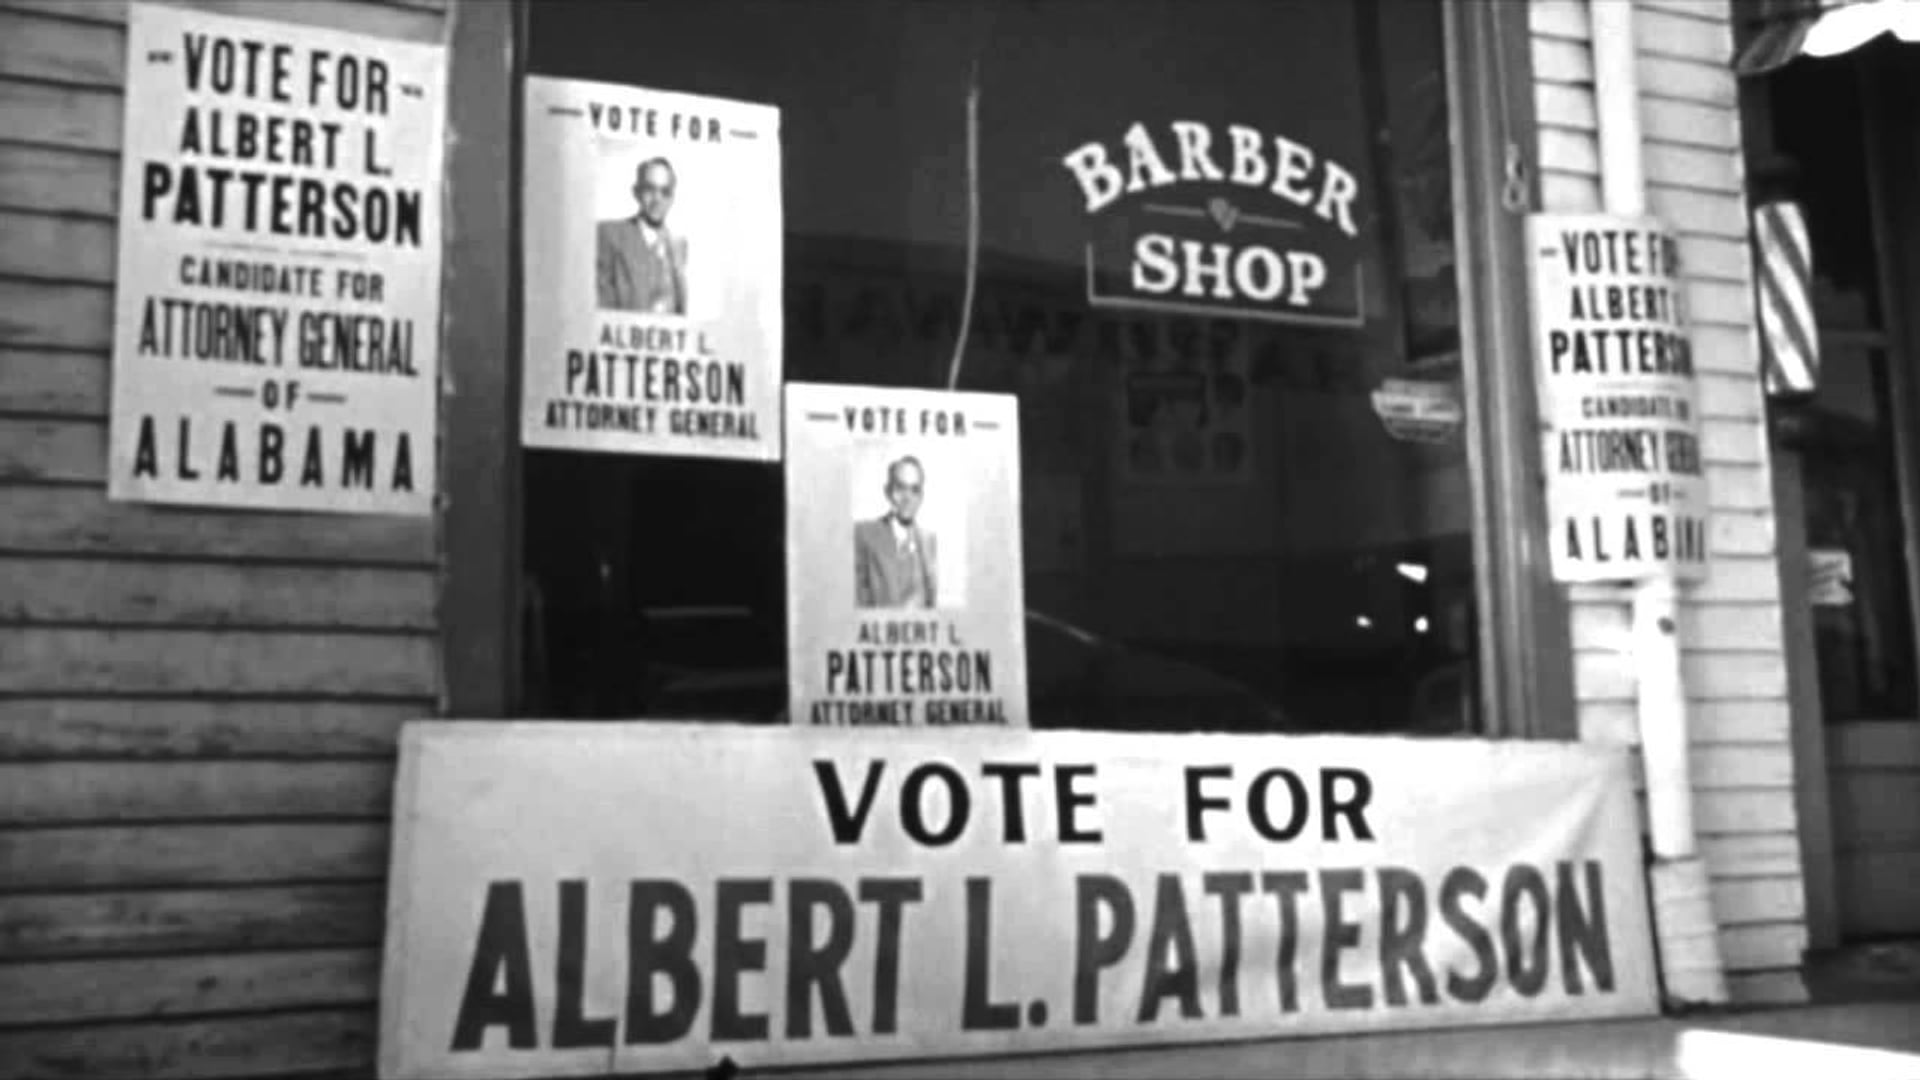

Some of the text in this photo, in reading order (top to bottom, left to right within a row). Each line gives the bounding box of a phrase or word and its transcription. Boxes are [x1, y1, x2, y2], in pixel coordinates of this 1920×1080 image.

[183, 32, 390, 115] VOTE FOR
[180, 105, 392, 176] ALBERT L.
[589, 102, 722, 143] VOTE FOR
[1063, 121, 1358, 237] BARBER
[143, 162, 421, 247] PATTERSON
[1132, 233, 1327, 306] SHOP
[1560, 230, 1642, 275] VOTE
[180, 256, 384, 303] CANDIDATE FOR
[1570, 284, 1670, 323] ALBERT
[138, 296, 418, 376] ATTORNEY GENERAL
[601, 323, 686, 353] ALBERT
[262, 379, 300, 411] OF
[566, 349, 745, 406] PATTERSON
[546, 401, 761, 440] ATTORNEY GENERAL
[843, 406, 967, 437] VOTE FOR
[134, 414, 414, 493] ALABAMA
[1559, 428, 1659, 474] ATTORNEY
[858, 621, 938, 645] ALBERT
[827, 650, 993, 695] PATTERSON
[810, 700, 1008, 726] ATTORNEY GENERAL
[813, 759, 1375, 847] VOTE FOR
[450, 859, 1615, 1052] ALBERT L. PATTERSON
